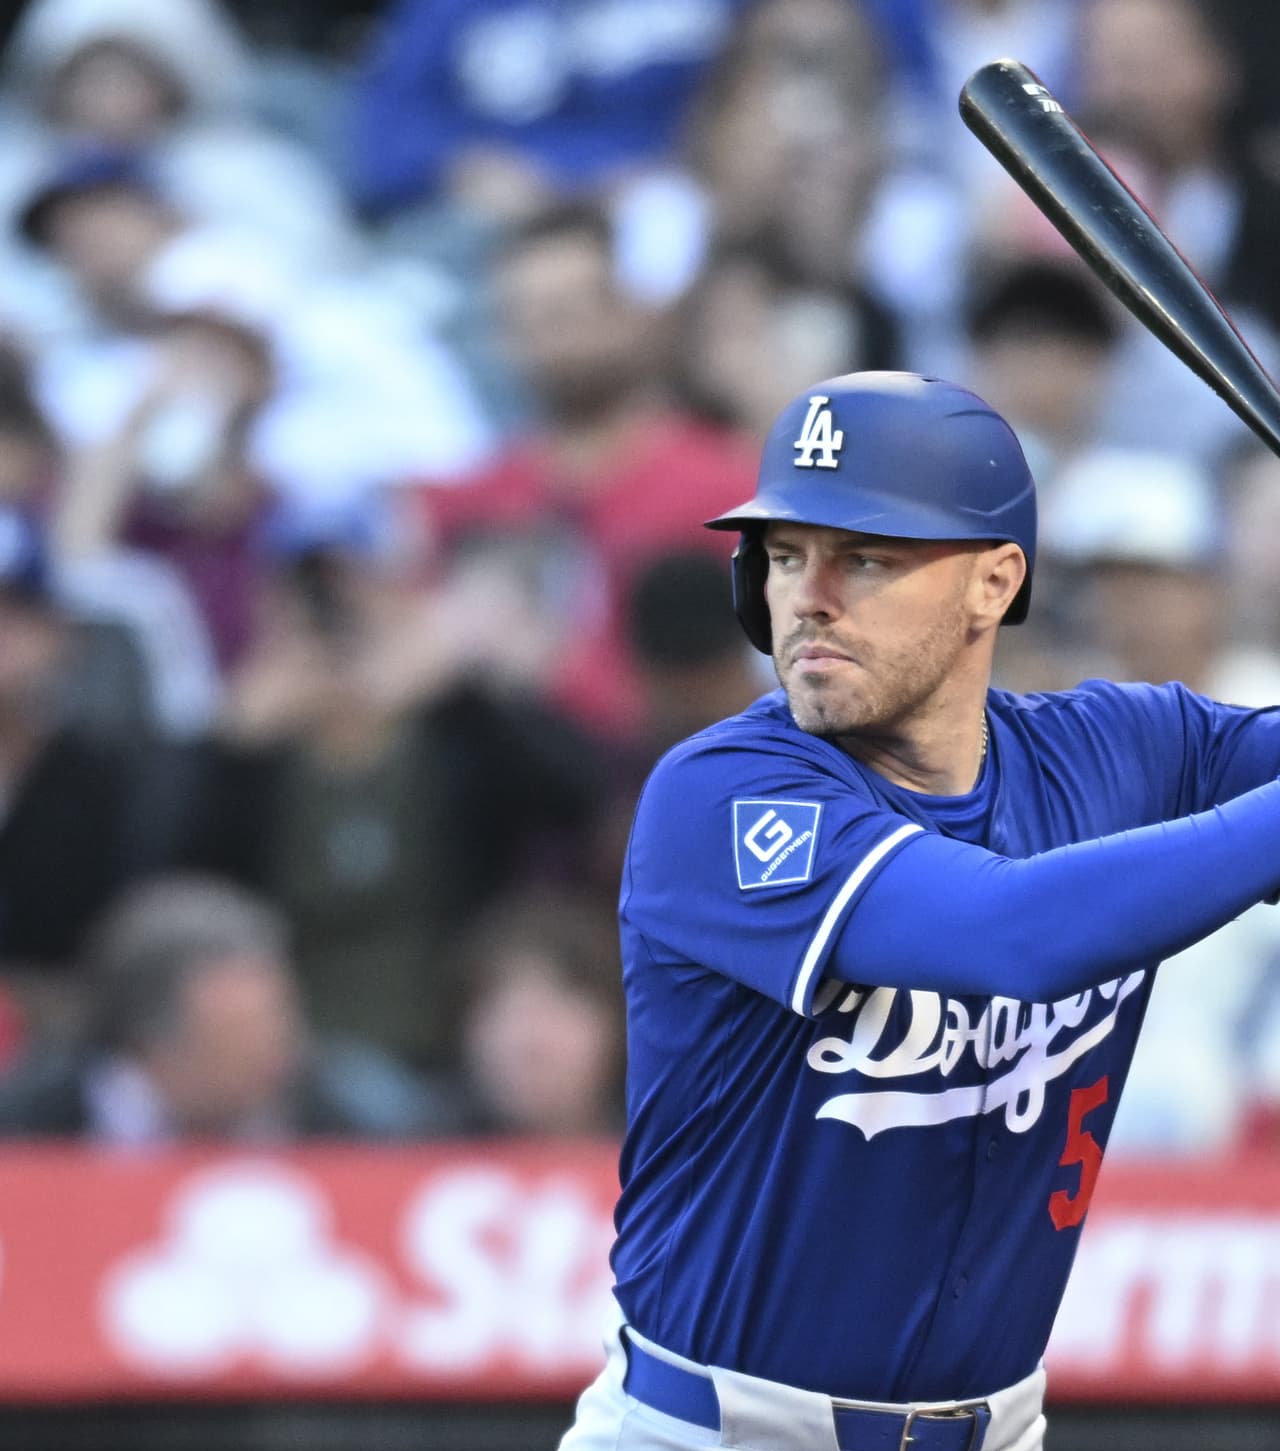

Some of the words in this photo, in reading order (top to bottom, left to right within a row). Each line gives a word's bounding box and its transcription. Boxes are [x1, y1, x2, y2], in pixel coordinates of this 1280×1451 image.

[793, 396, 843, 468] LA
[744, 809, 793, 862] G
[761, 830, 813, 882] GUGGENHEIM
[1048, 1075, 1108, 1231] 5
